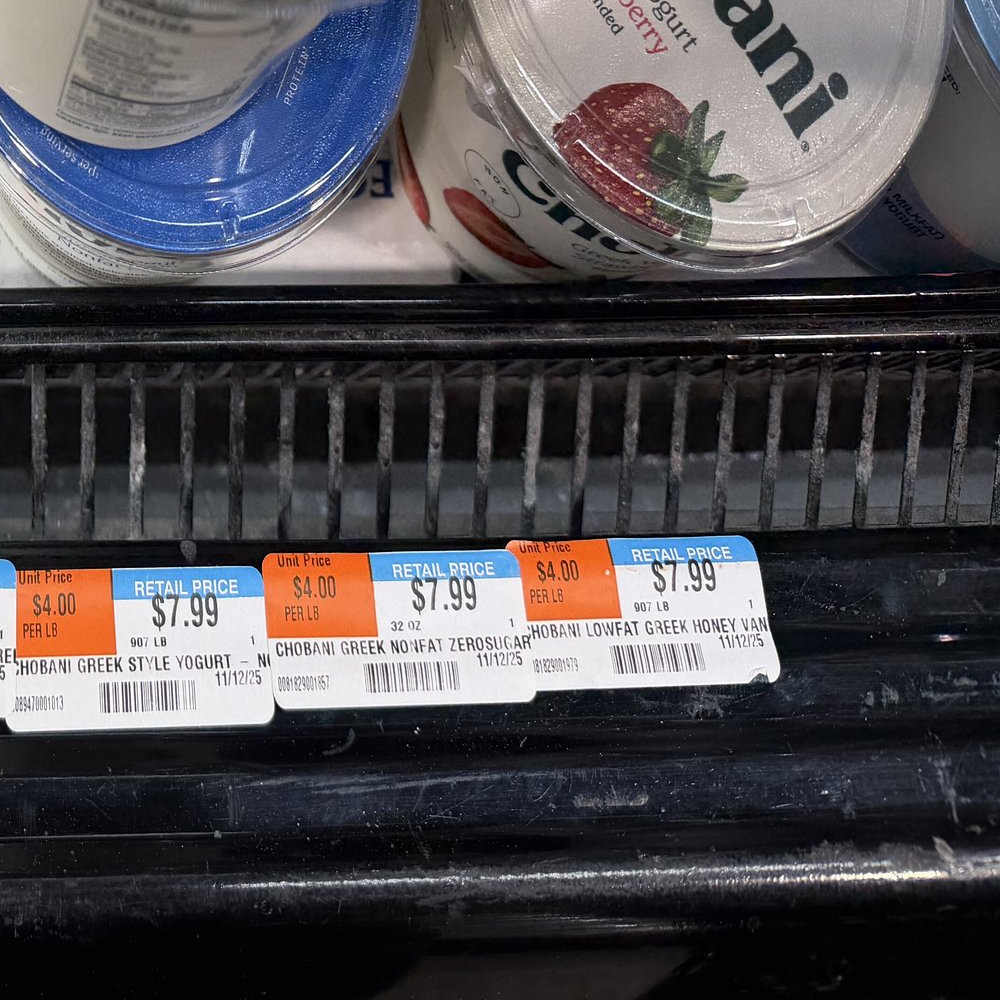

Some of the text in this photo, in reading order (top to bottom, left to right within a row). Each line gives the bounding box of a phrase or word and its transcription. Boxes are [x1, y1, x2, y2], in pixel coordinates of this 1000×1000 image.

[538, 559, 580, 583] $4.00
[652, 558, 717, 596] $7.99
[135, 580, 238, 596] RETAIL PRICE
[294, 576, 336, 600] $4.00
[412, 575, 476, 615] $7.99
[33, 593, 76, 618] $4.00
[152, 592, 218, 631] $7.99
[587, 621, 639, 637] LOWFAT
[645, 620, 688, 635] GREEK
[693, 618, 736, 633] HONEY
[741, 617, 768, 632] VAN
[276, 641, 335, 658] CHOBANI
[341, 640, 386, 656] GREEK
[391, 639, 443, 655] NONFAT
[78, 658, 122, 673] GREEK
[128, 655, 170, 672] STYLE
[176, 654, 231, 670] YOGURT
